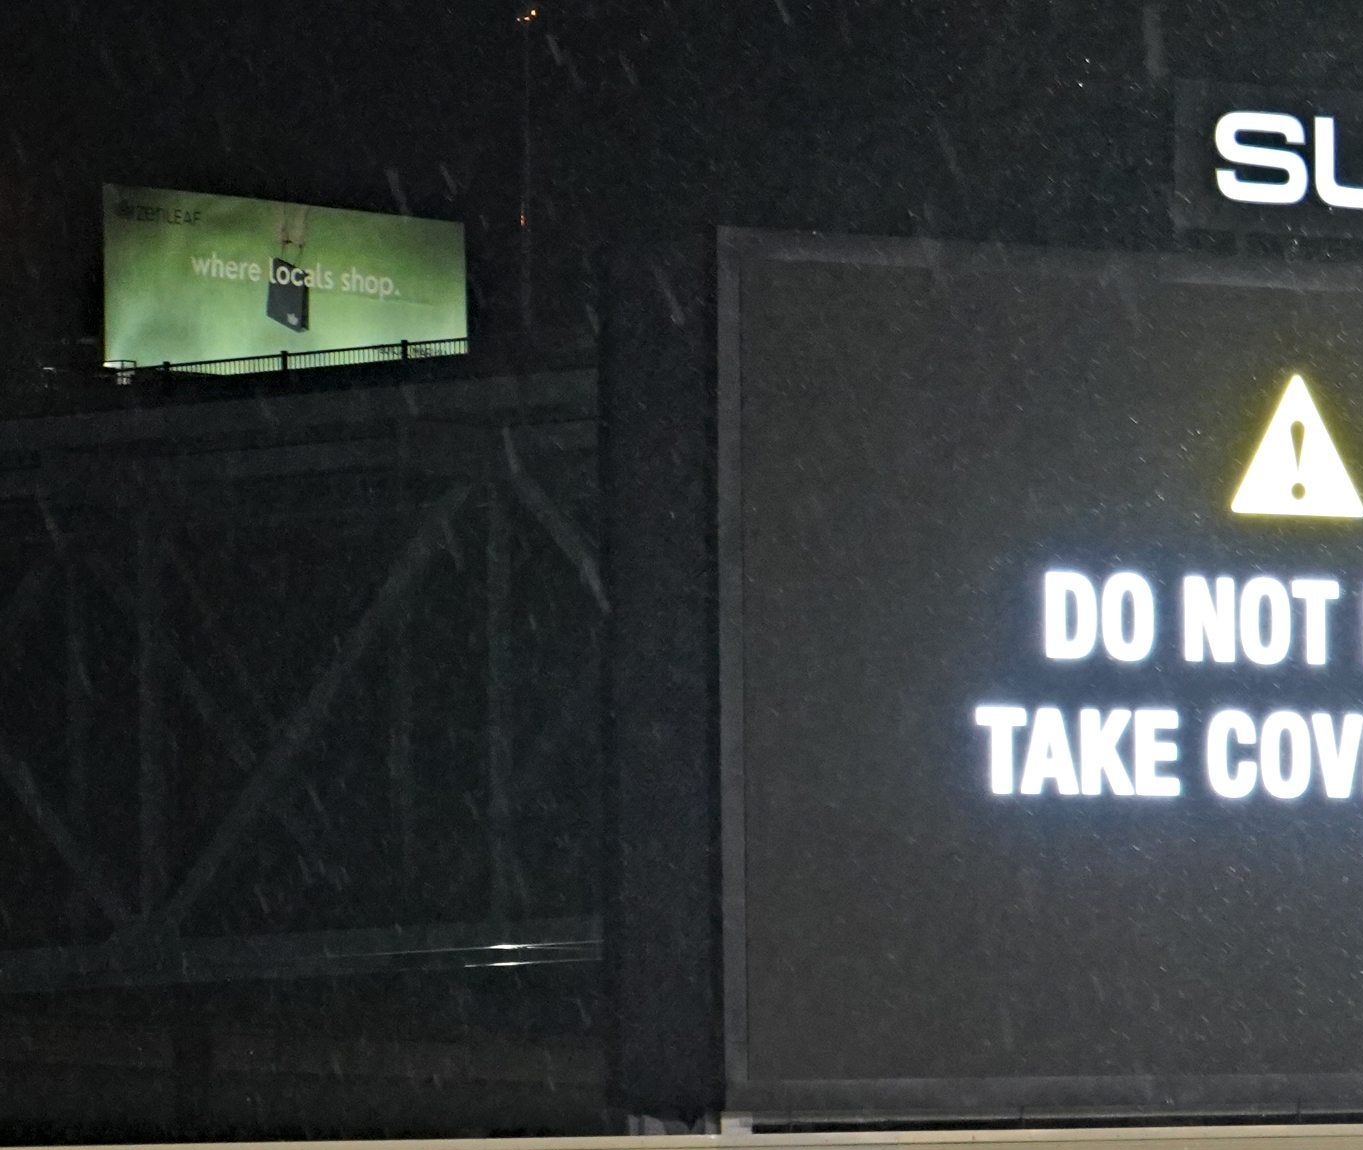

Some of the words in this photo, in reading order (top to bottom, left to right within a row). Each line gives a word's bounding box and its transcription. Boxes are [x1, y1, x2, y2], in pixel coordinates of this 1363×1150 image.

[190, 253, 262, 282] where
[269, 256, 334, 290] locals
[341, 266, 401, 301] shop.
[1043, 569, 1156, 663] DO
[1182, 574, 1341, 667] NOT
[974, 704, 1182, 798] TAKE
